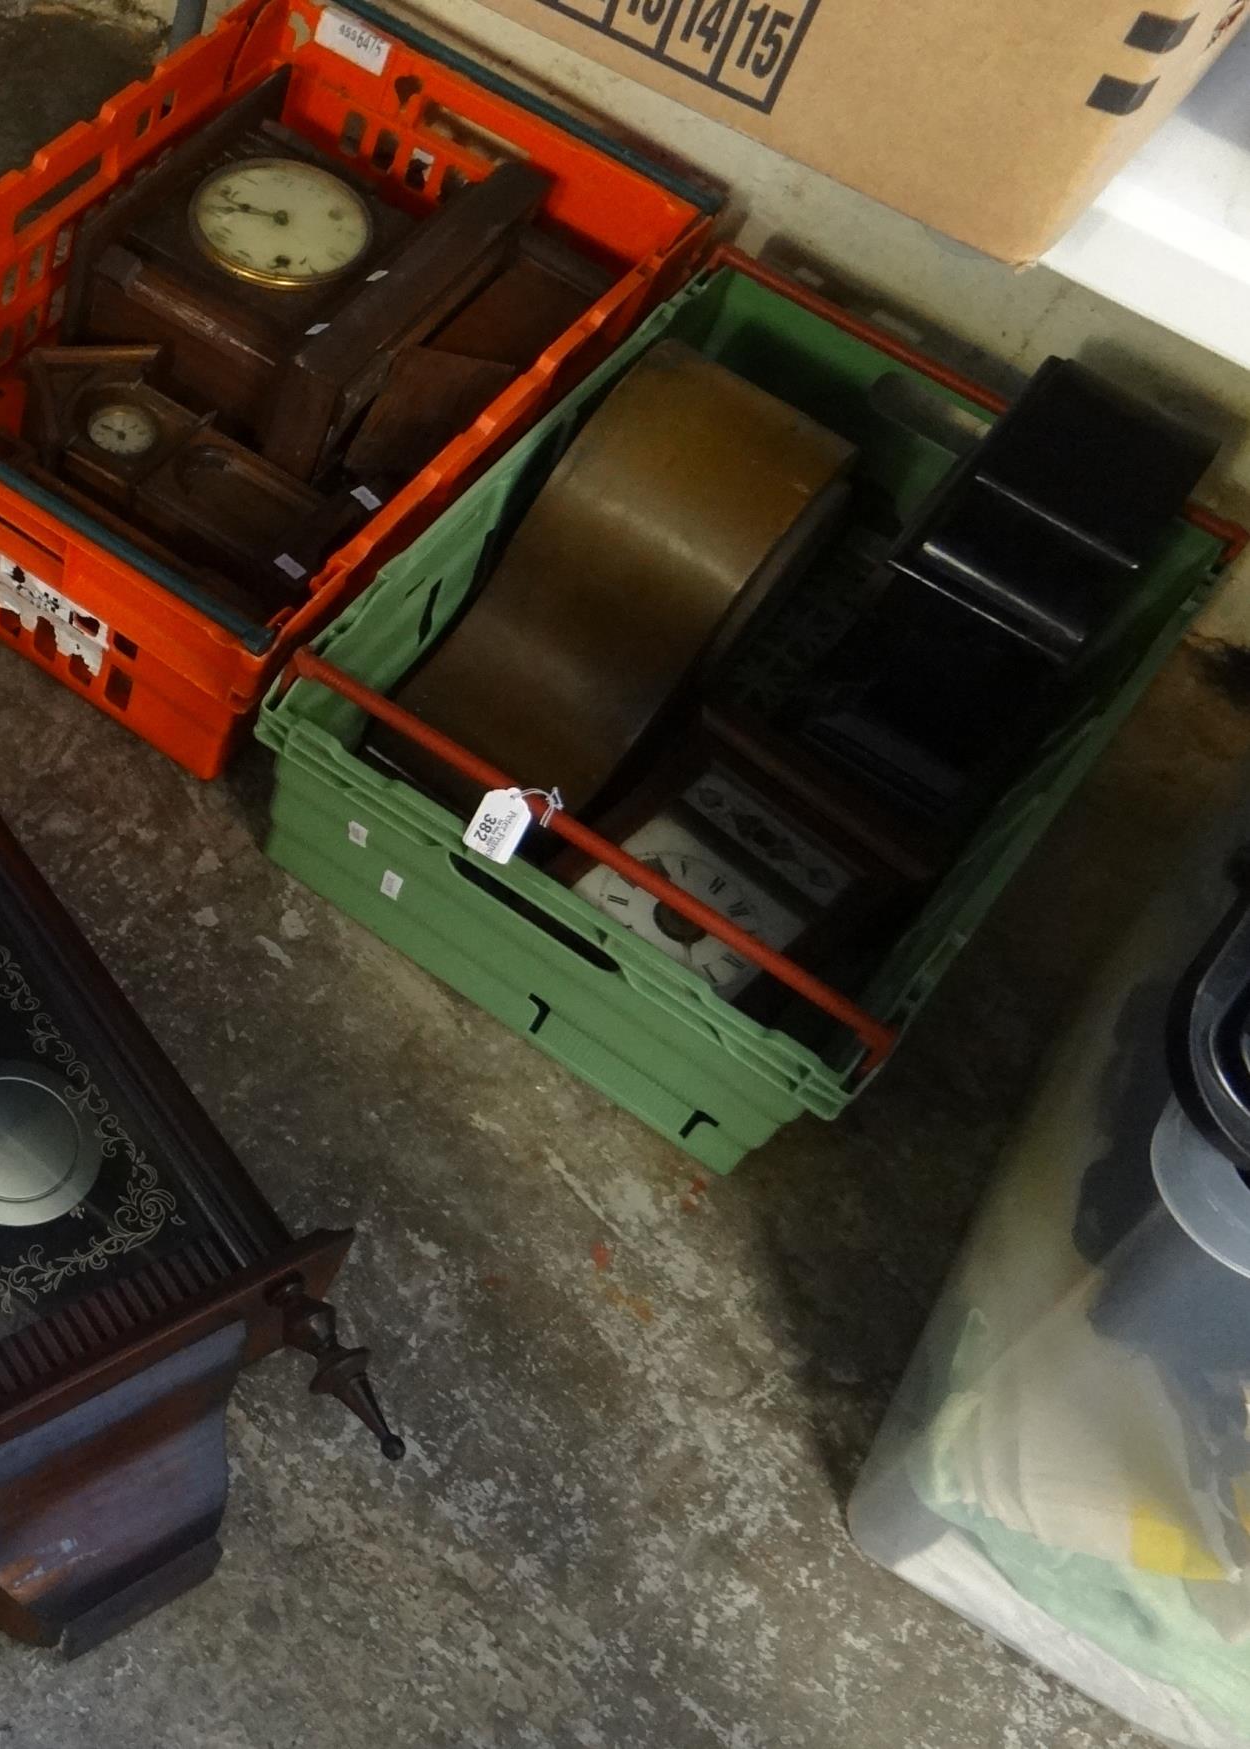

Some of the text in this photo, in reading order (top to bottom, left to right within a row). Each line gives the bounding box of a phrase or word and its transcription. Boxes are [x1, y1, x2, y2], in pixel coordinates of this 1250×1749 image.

[679, 0, 729, 53] 14
[735, 3, 793, 79] 15
[473, 813, 498, 842] 382
